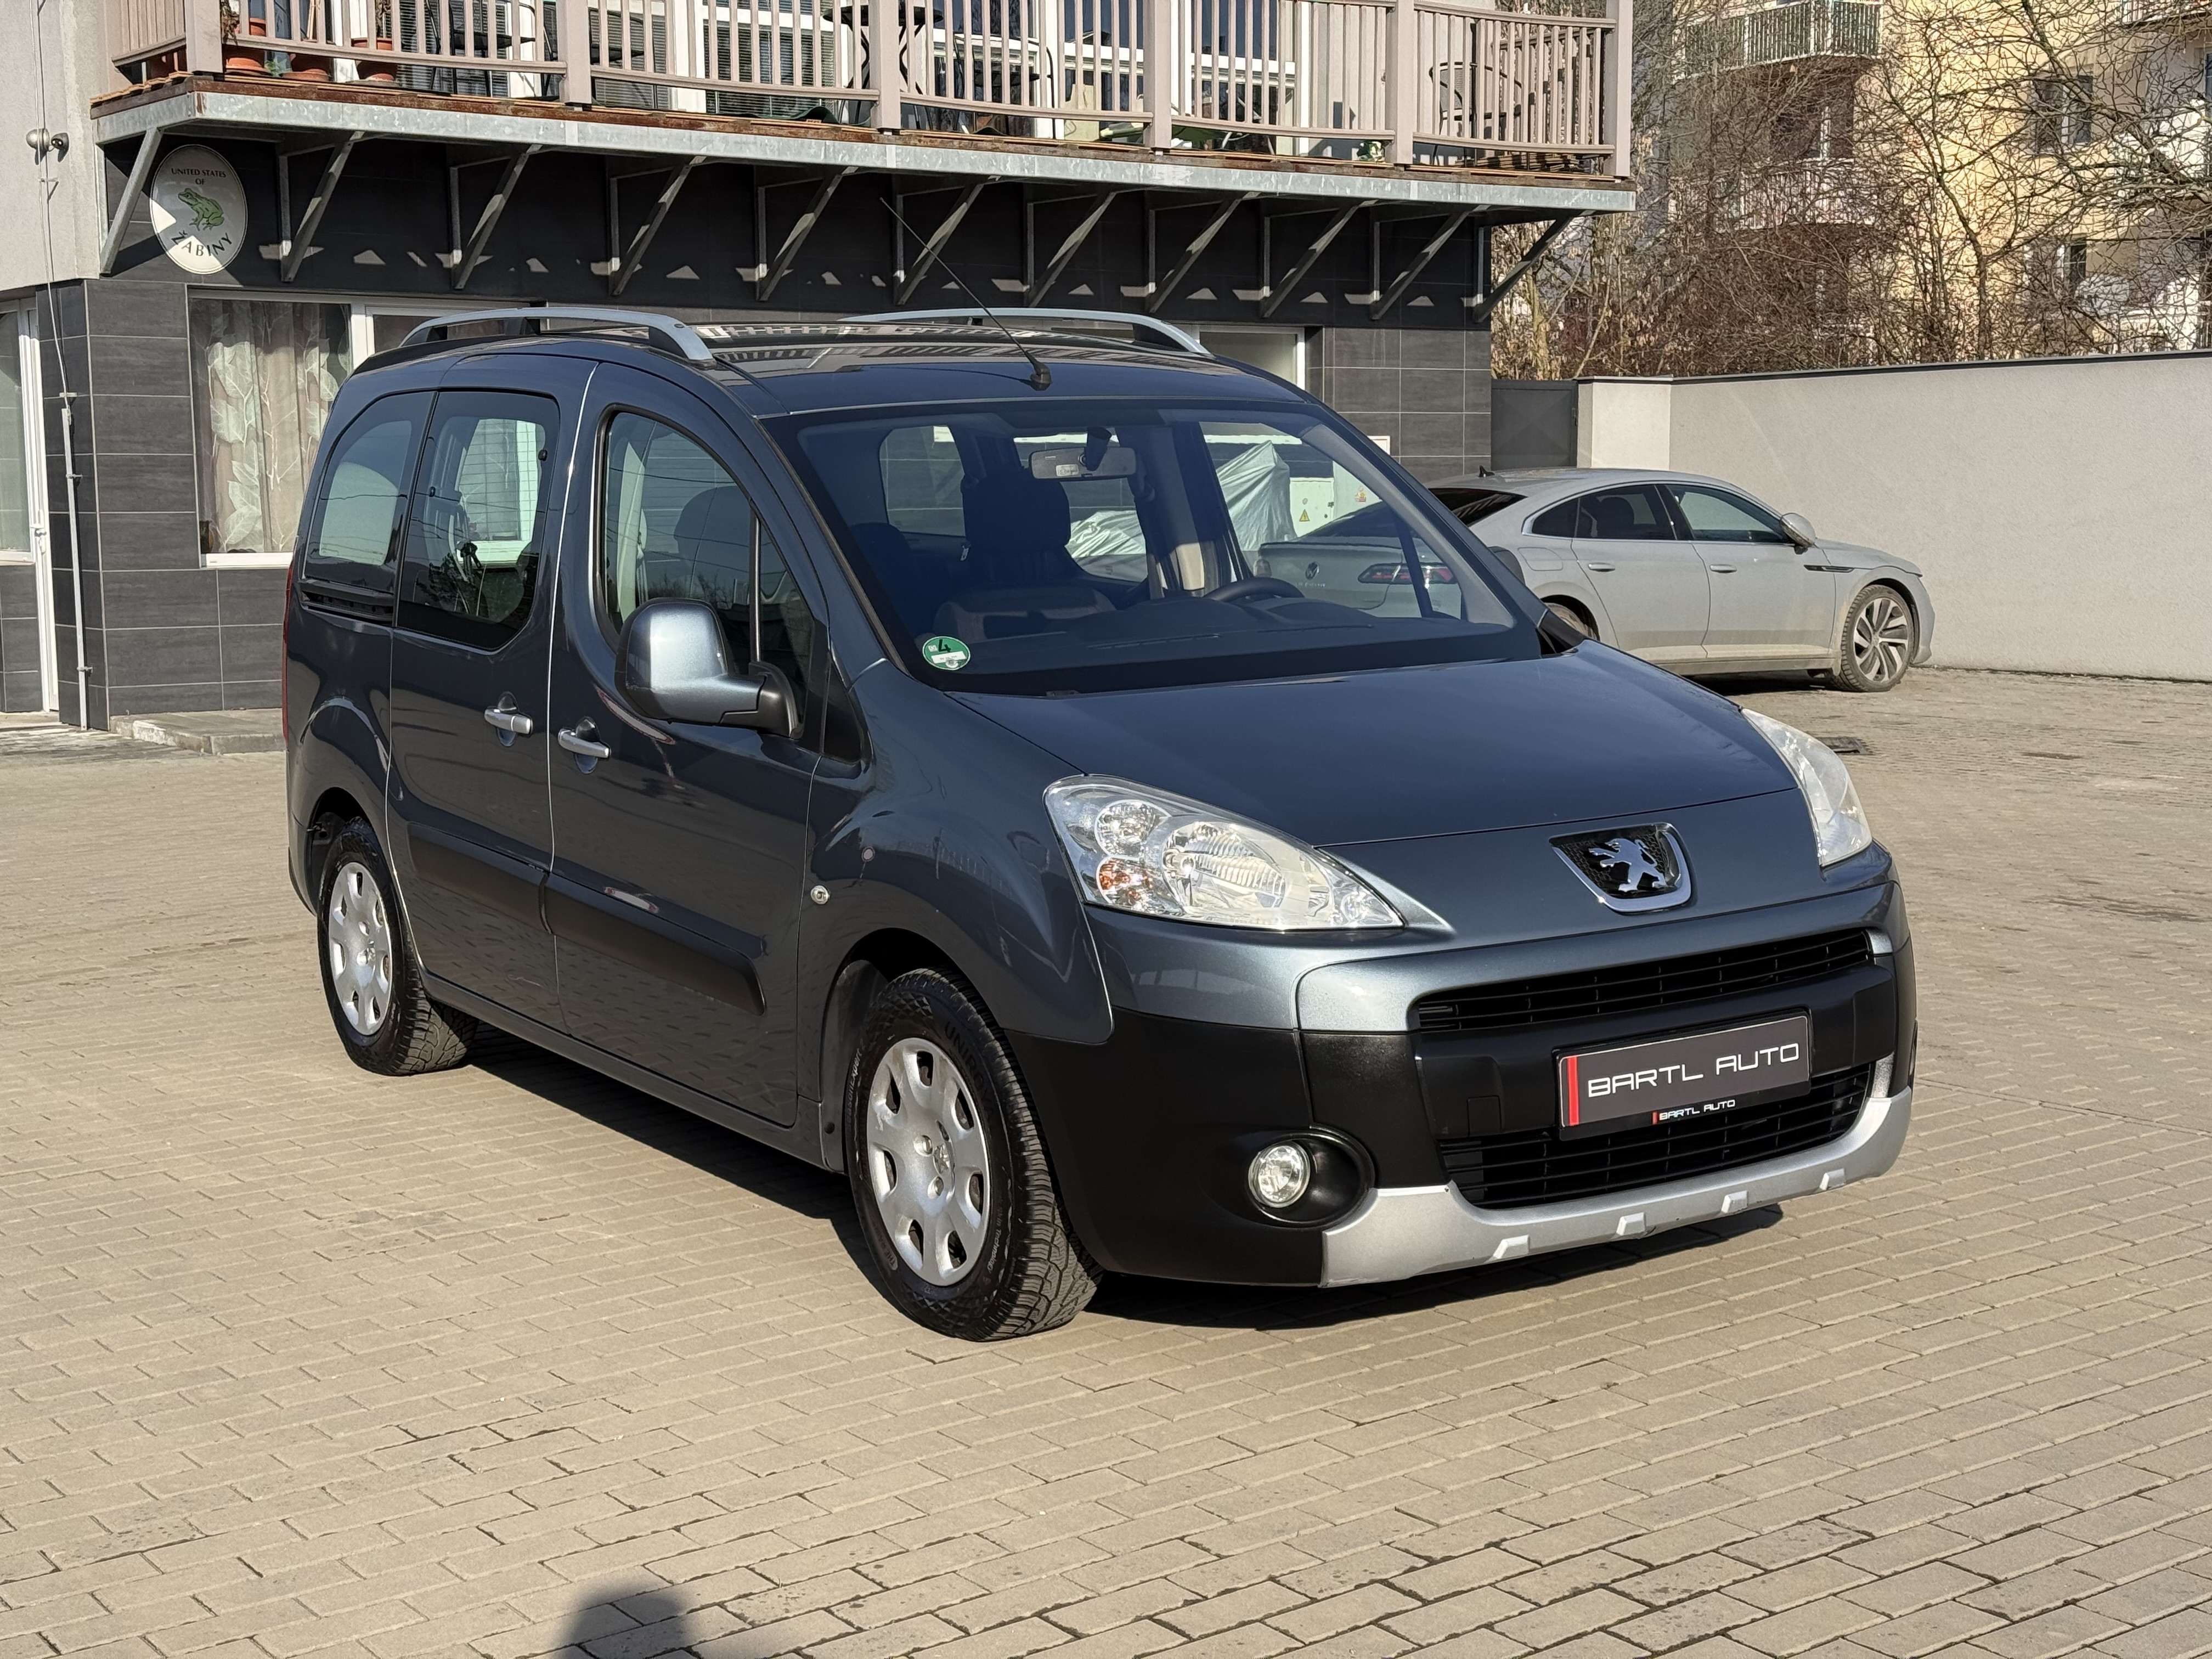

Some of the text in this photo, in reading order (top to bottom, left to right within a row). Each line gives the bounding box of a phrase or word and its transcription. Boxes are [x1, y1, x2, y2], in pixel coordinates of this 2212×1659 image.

[171, 230, 232, 256] ŽABINY
[939, 639, 951, 652] 4
[945, 1021, 995, 1119] UNIROYA
[1588, 1043, 1799, 1098] BARTL AUTO
[1659, 1099, 1736, 1120] BARTL AUTO
